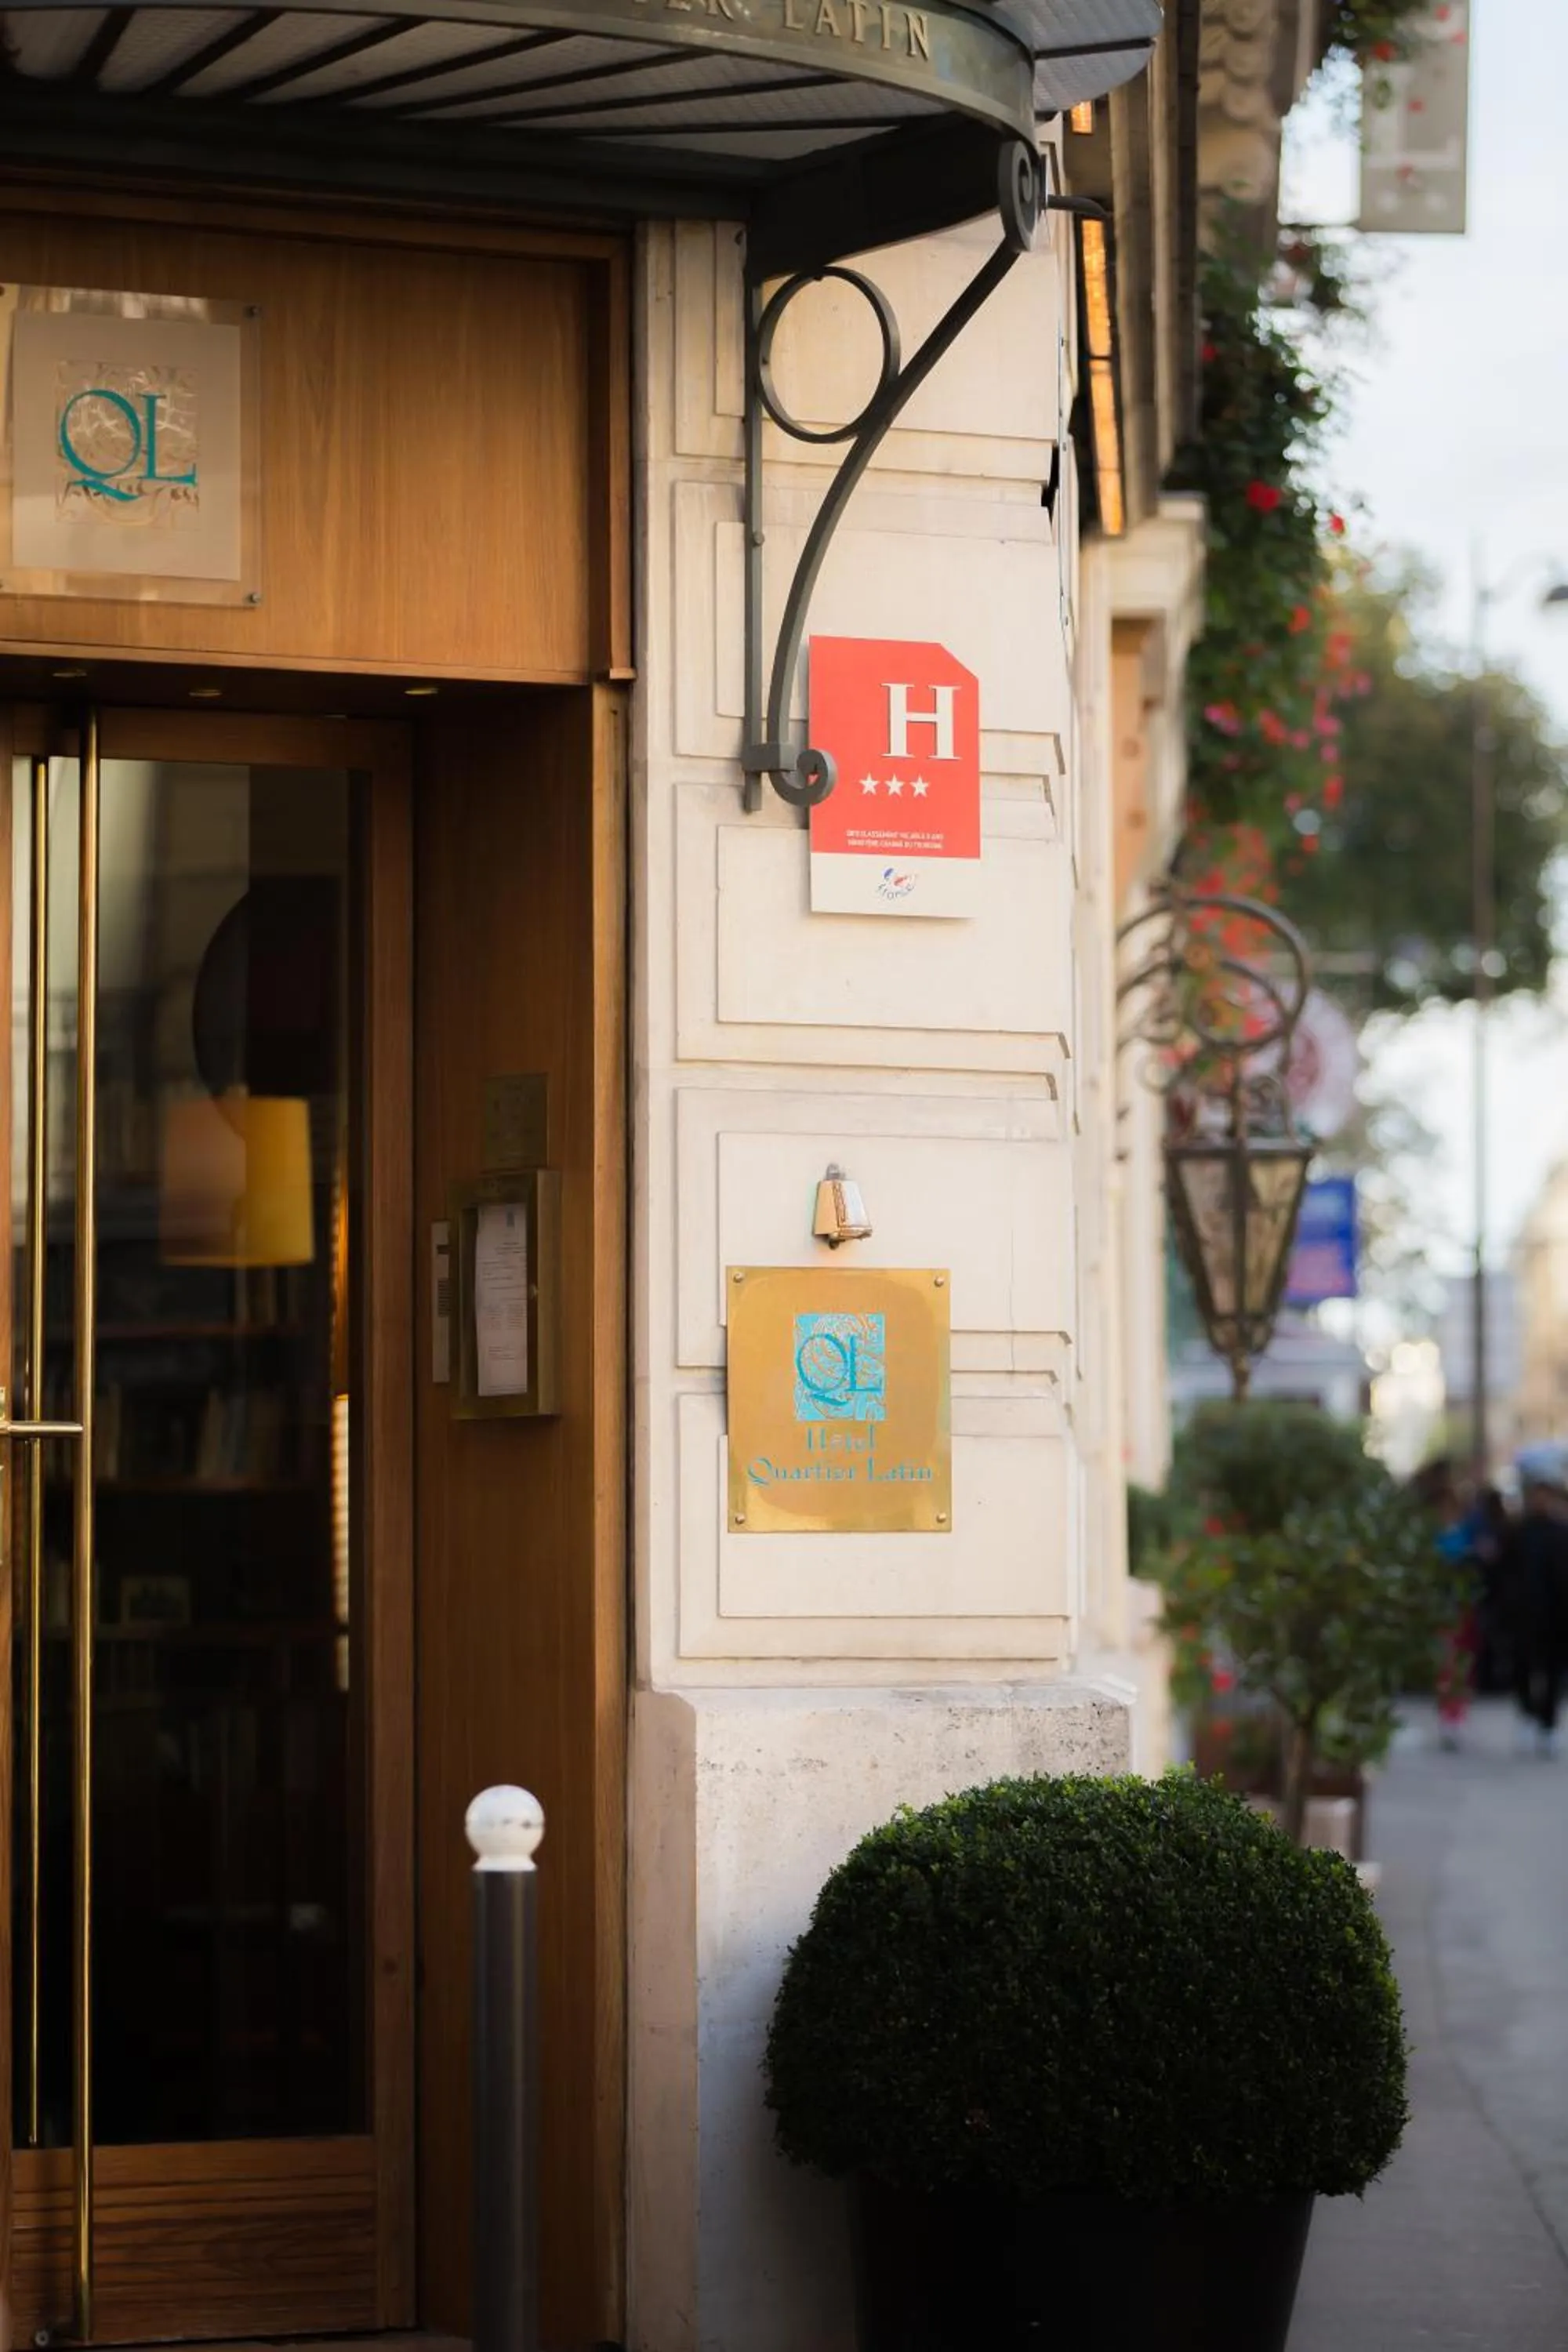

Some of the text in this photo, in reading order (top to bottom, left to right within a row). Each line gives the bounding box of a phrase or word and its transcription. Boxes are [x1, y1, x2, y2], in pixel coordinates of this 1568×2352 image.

[784, 0, 930, 60] LATIN
[60, 389, 197, 502] QL
[880, 683, 962, 760] H
[748, 1455, 933, 1486] Quartier Latin
